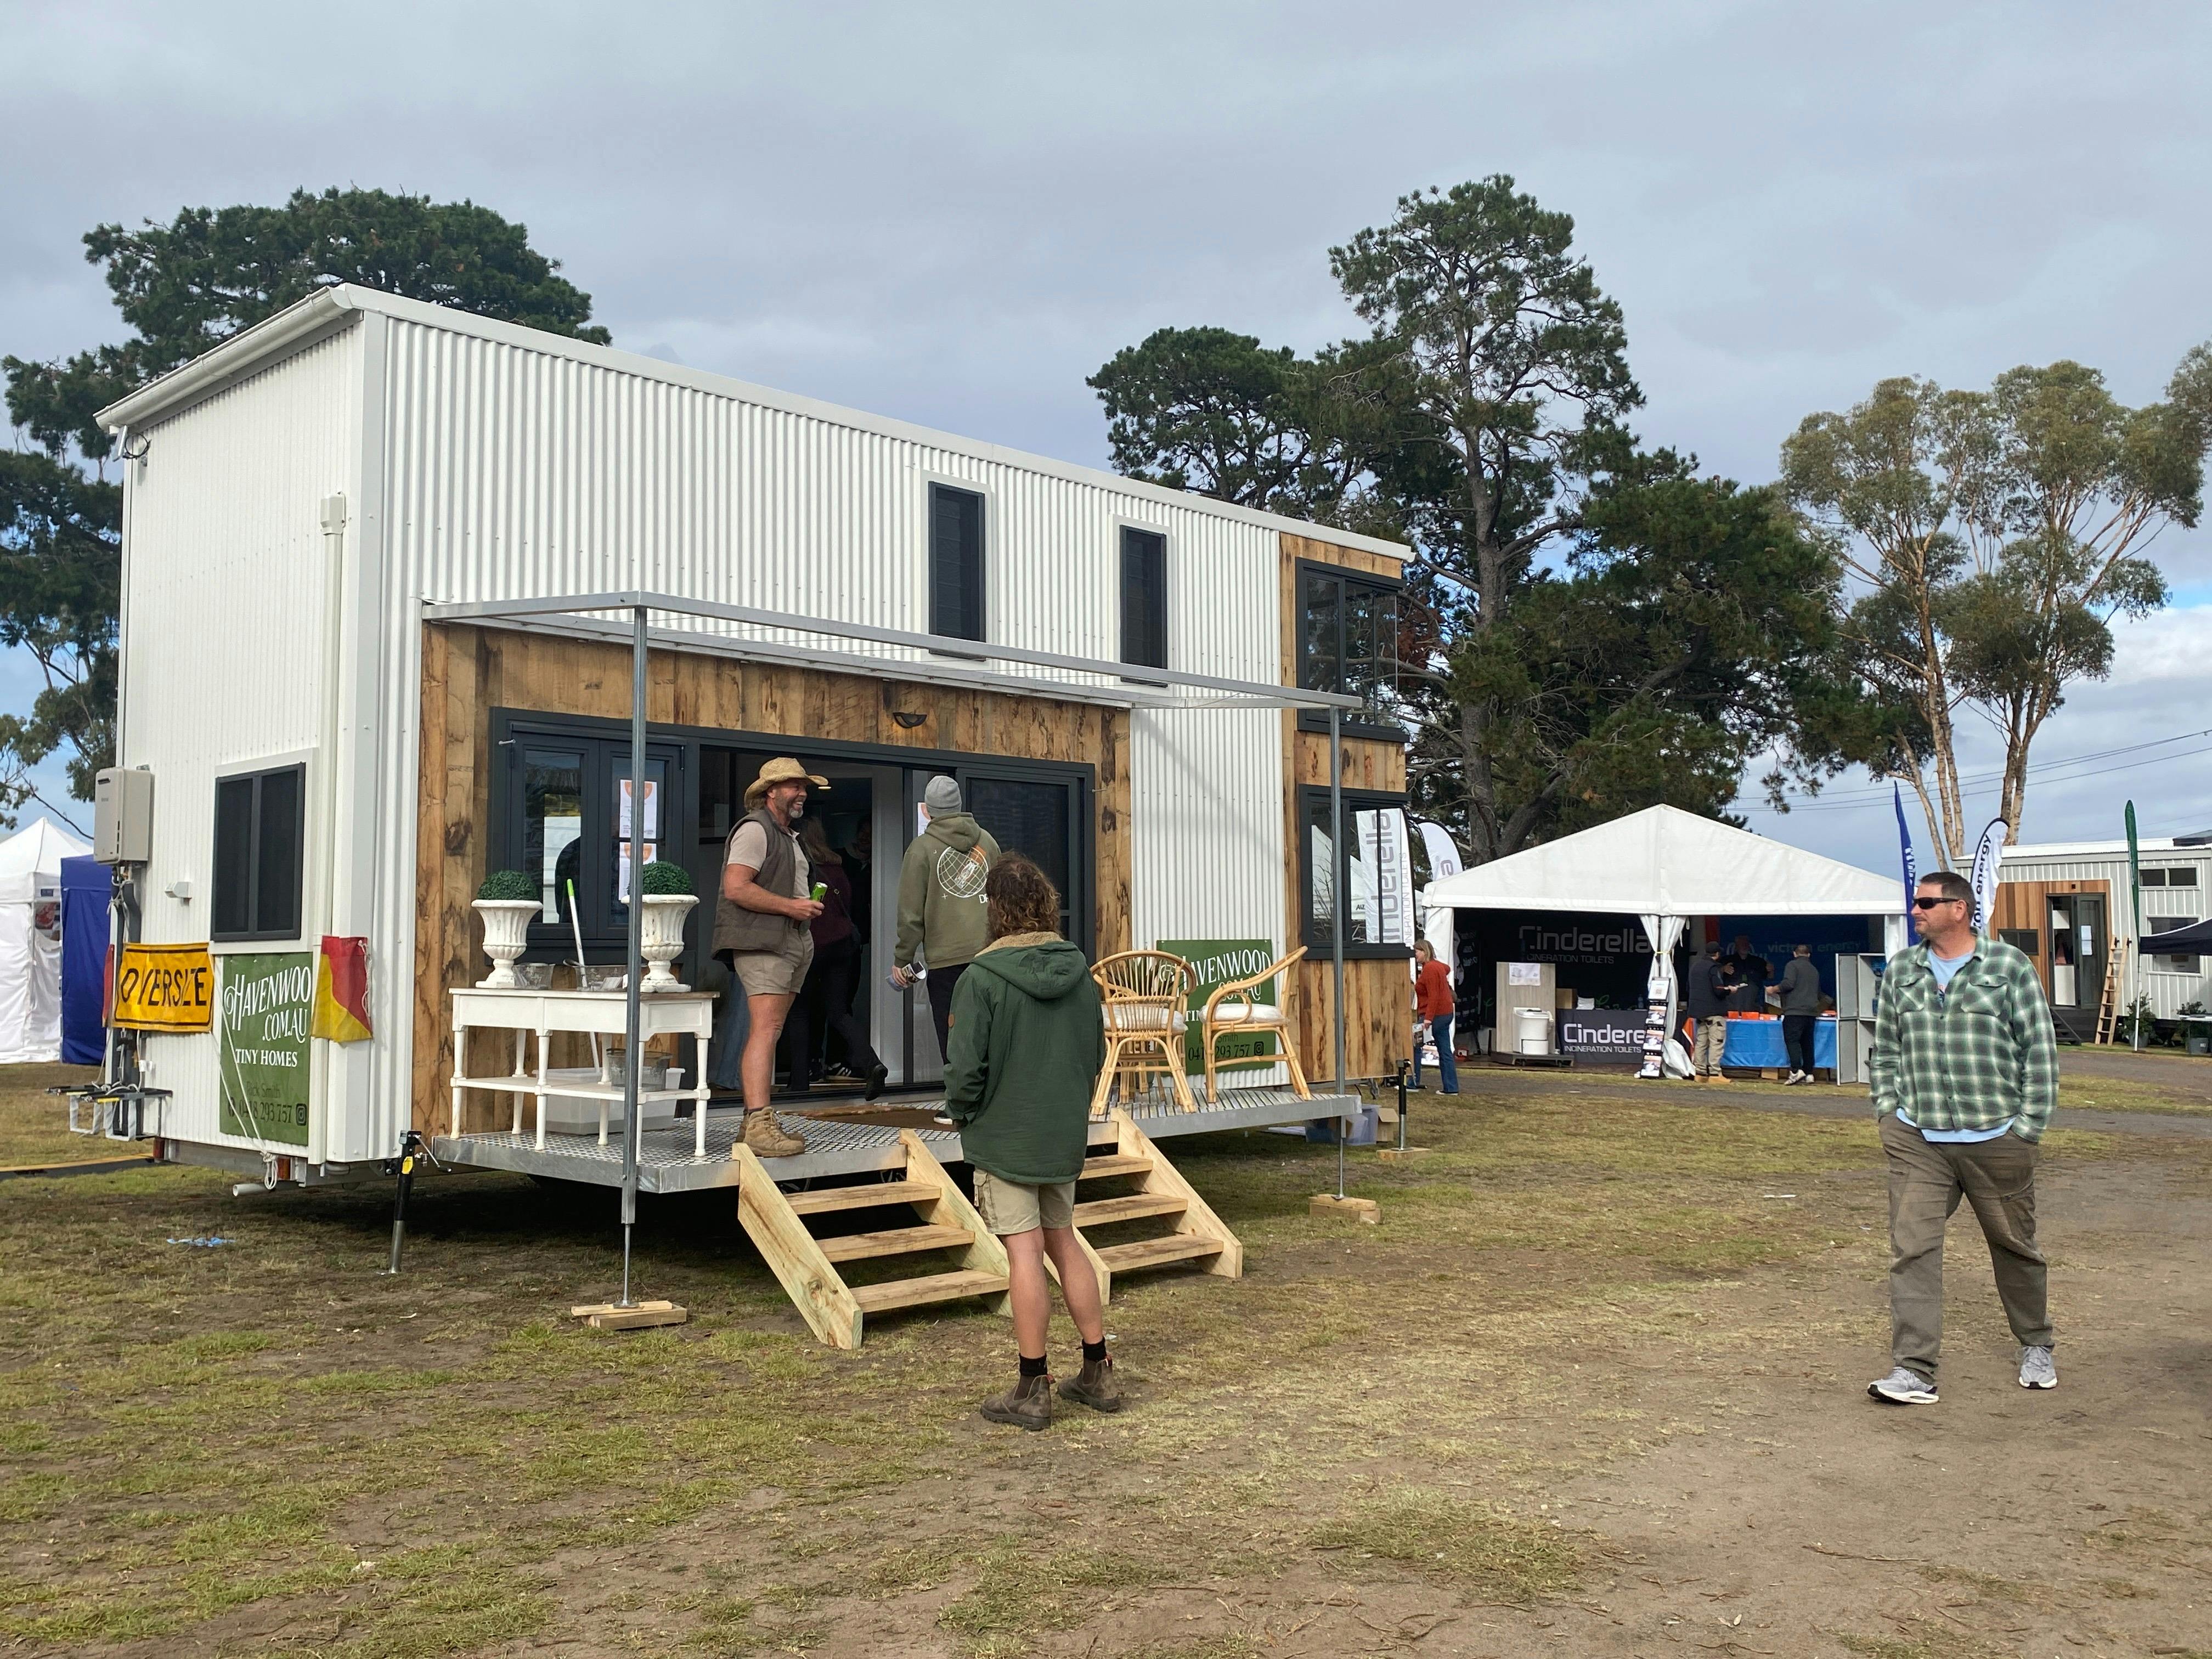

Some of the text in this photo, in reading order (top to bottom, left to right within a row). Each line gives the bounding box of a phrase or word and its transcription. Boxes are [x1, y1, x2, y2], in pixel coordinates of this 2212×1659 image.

[1976, 834, 1991, 895] energy
[1581, 955, 1615, 964] TOILETS
[121, 967, 207, 1007] OVERSIZE
[262, 1008, 308, 1043] .COM.AU
[235, 1049, 298, 1068] TINY HOMES
[1234, 1044, 1250, 1057] 757
[261, 1082, 281, 1098] Smith
[260, 1102, 274, 1123] 293
[277, 1104, 292, 1123] 757
